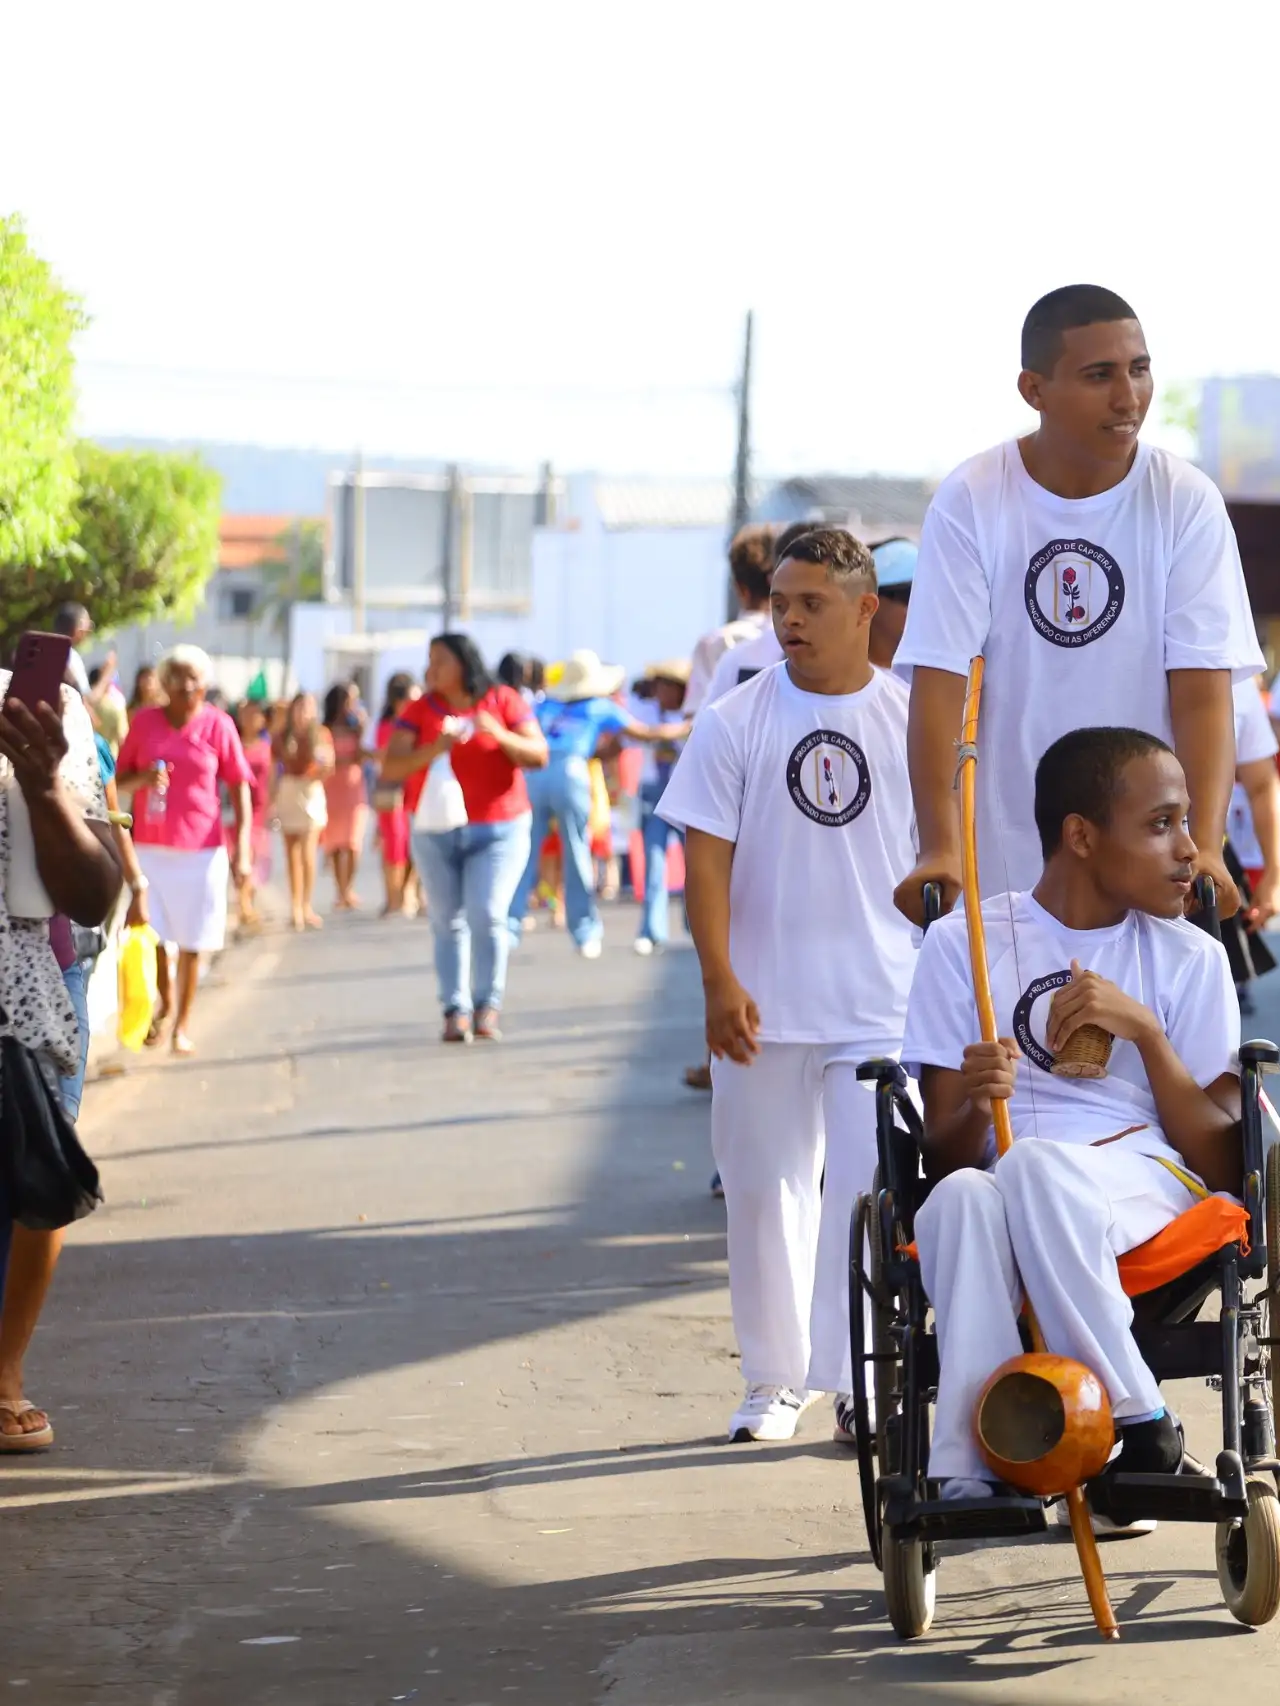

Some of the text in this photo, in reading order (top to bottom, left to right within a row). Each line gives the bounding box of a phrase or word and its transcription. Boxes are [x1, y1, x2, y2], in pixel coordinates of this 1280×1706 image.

[1031, 542, 1113, 573] PROJETO DE CAPOEIRA
[1028, 599, 1055, 637] GINGANDO
[1071, 635, 1082, 644] AS
[1083, 600, 1119, 641] DIFERENÇAS
[830, 735, 863, 766] CAPOEIRA
[792, 786, 819, 819] GINGANDO
[1028, 976, 1064, 999] PROJETO
[1018, 1023, 1045, 1062] GINGANDO
